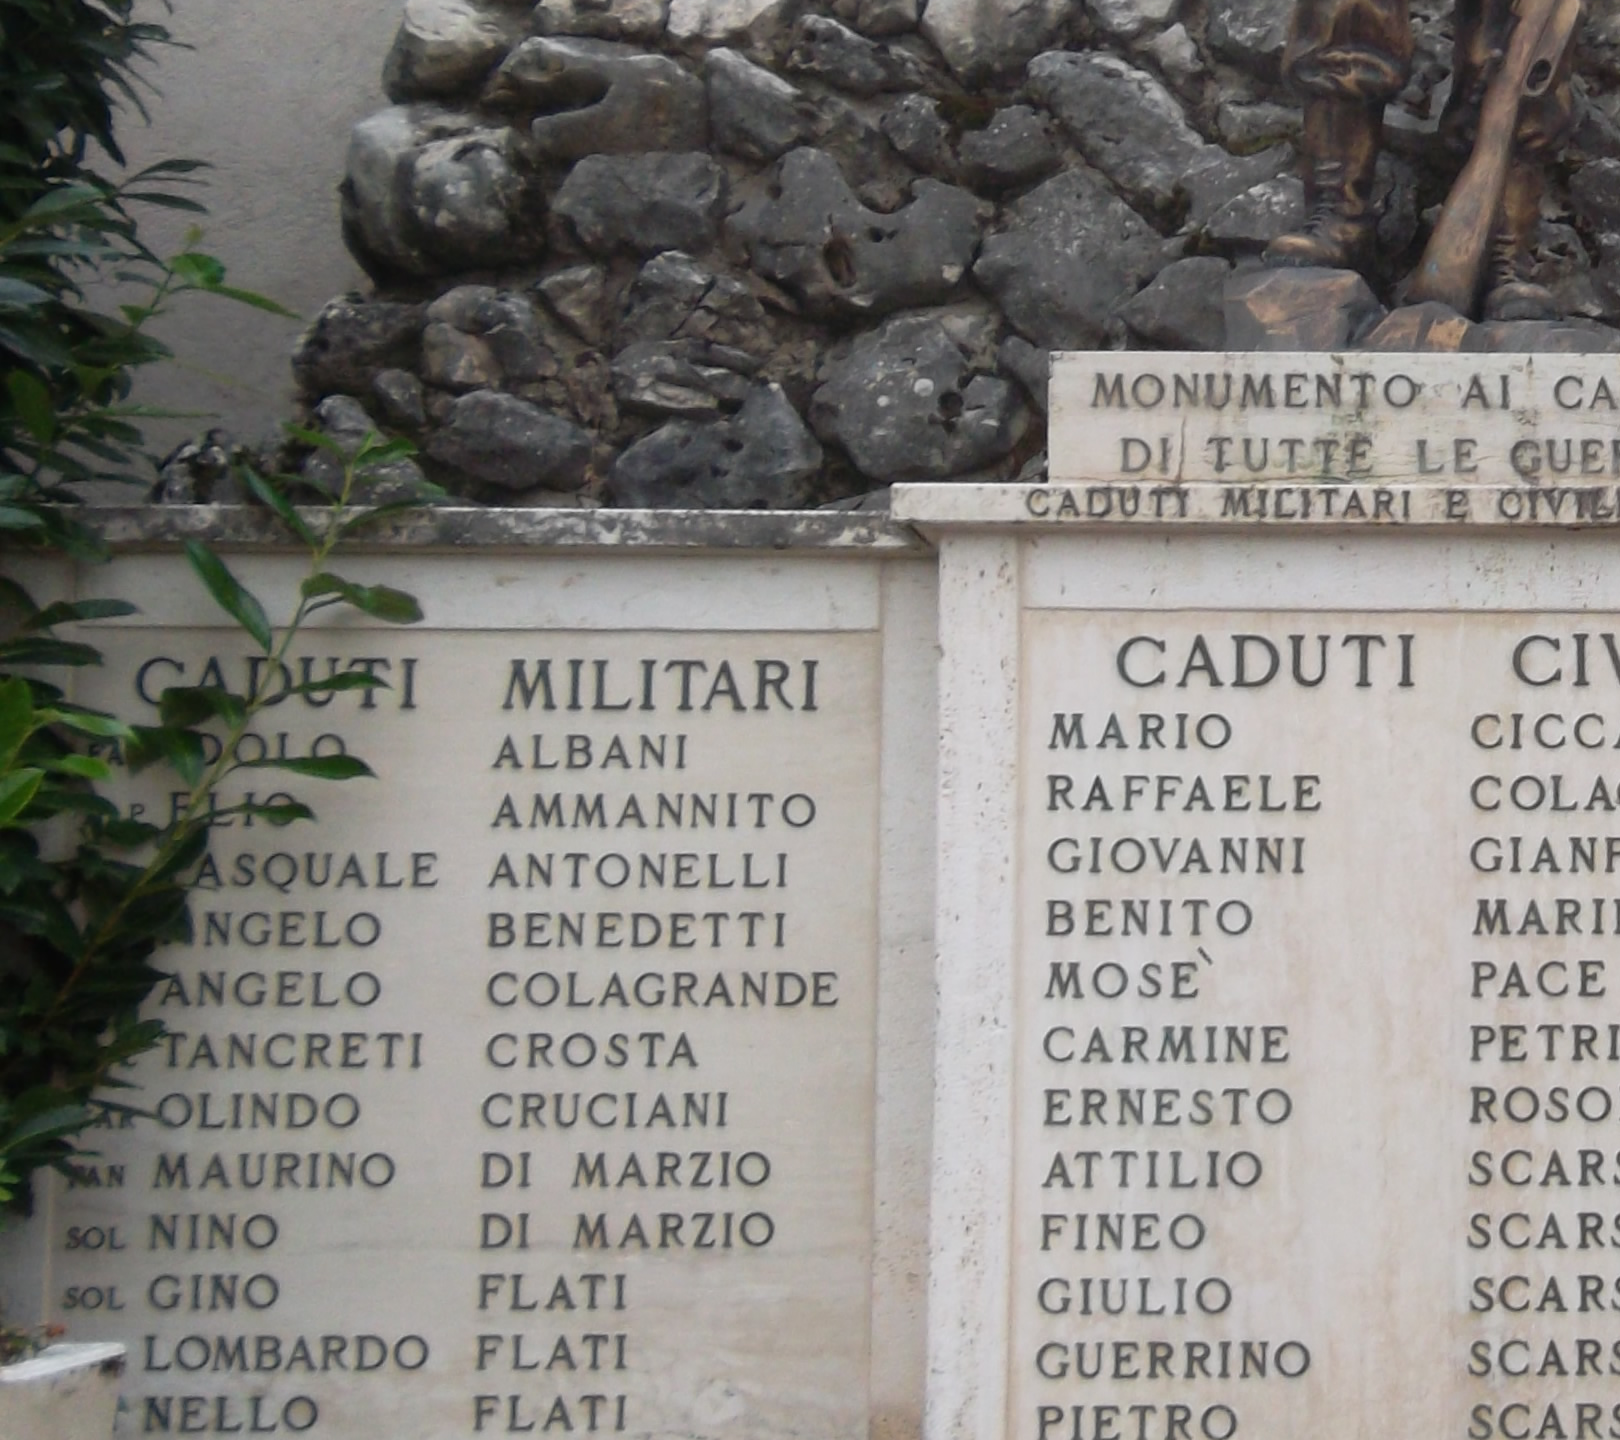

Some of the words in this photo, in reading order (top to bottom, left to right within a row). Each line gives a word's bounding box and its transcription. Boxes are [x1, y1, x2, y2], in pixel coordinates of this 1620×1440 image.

[1091, 372, 1418, 409] MONUMENTO
[1460, 373, 1510, 410] AI
[1119, 437, 1172, 473] DI
[1206, 436, 1374, 477] TUTTE
[1415, 438, 1479, 474] LE
[1025, 488, 1190, 518] CADUTI
[1117, 635, 1414, 688] CADUTI
[134, 656, 420, 710] CADUTI
[502, 659, 818, 712] MILITARI
[196, 732, 347, 766] DOLO
[492, 734, 686, 770] ALBANI
[1049, 714, 1231, 750] MARIO
[491, 793, 816, 829] AMMANNITO
[1048, 775, 1321, 812] RAFFAELE
[188, 852, 439, 895] ASQUALE
[488, 853, 787, 889] ANTONELLI
[1048, 837, 1304, 874] GIOVANNI
[488, 912, 785, 948] BENEDETTI
[1047, 900, 1252, 936] BENITO
[160, 971, 382, 1008] ANGELO
[487, 972, 838, 1008] COLAGRANDE
[1472, 961, 1605, 998] PACE
[164, 1032, 424, 1068] TANCRETI
[486, 1033, 697, 1068] CROSTA
[1044, 1026, 1289, 1063] CARMINE
[155, 1092, 361, 1130] OLINDO
[482, 1092, 727, 1129] CRUCIANI
[1044, 1088, 1292, 1126] ERNESTO
[149, 1151, 395, 1191] MAURINO
[481, 1152, 530, 1189] DI
[572, 1152, 770, 1188] MARZIO
[1042, 1151, 1262, 1189] ATTILIO
[64, 1225, 124, 1252] SOL
[148, 1213, 278, 1251] NINO
[480, 1213, 529, 1250] DI
[573, 1212, 774, 1250] MARZIO
[1041, 1214, 1206, 1251] FINEO
[62, 1286, 124, 1312] SOL
[147, 1274, 279, 1312] GINO
[478, 1274, 625, 1311] FLATI
[1038, 1278, 1232, 1316] GIULIO
[142, 1333, 428, 1373] LOMBARDO
[476, 1334, 626, 1371] FLATI
[1036, 1341, 1310, 1379] GUERRINO
[142, 1395, 318, 1435] NELLO
[474, 1395, 626, 1432] FLATI
